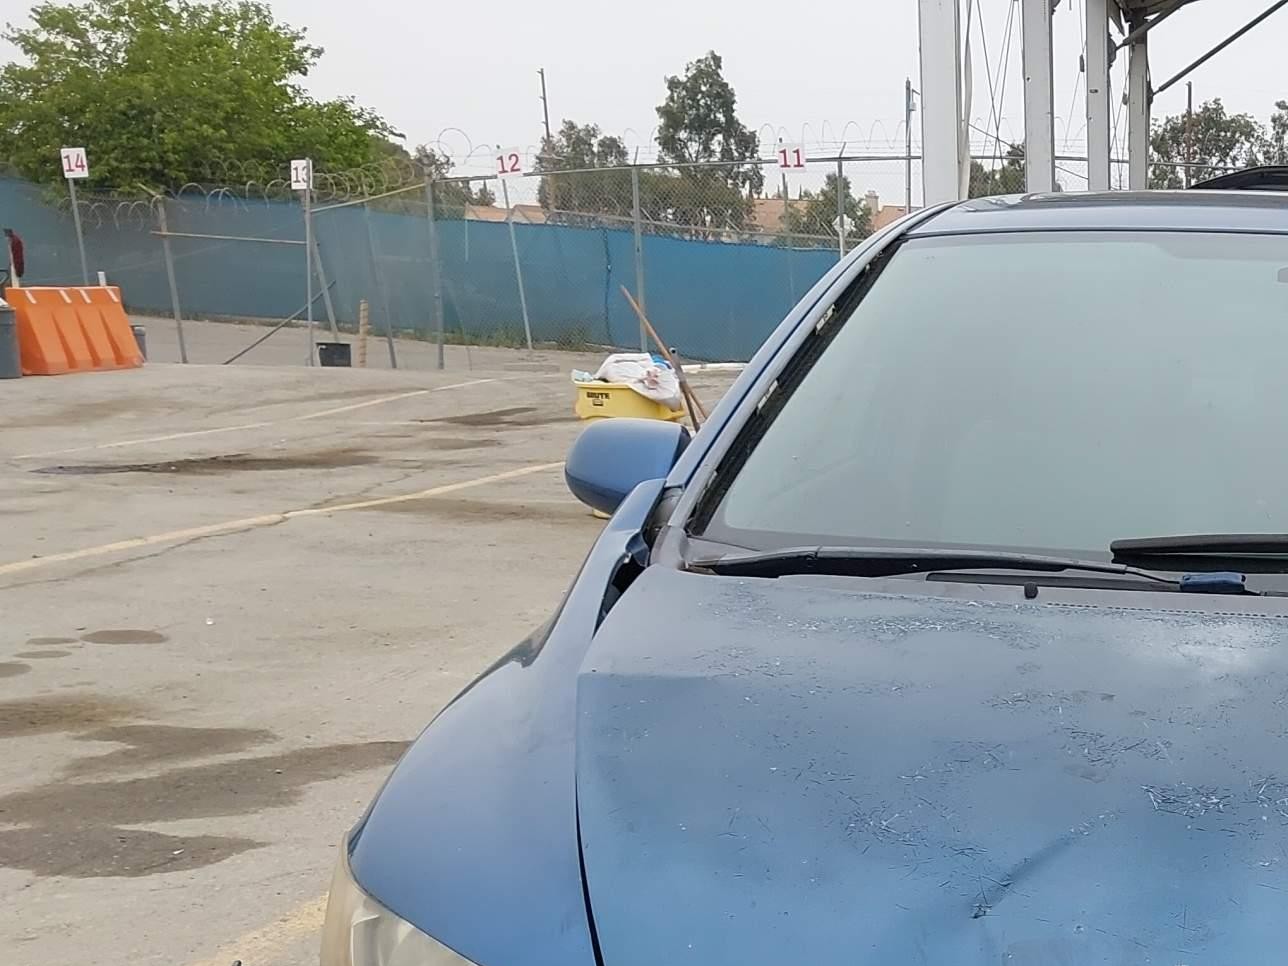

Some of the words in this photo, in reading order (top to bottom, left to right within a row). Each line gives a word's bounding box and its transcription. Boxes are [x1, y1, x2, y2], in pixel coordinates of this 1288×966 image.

[63, 153, 86, 172] 14
[496, 153, 521, 174] 12
[779, 148, 805, 168] 11
